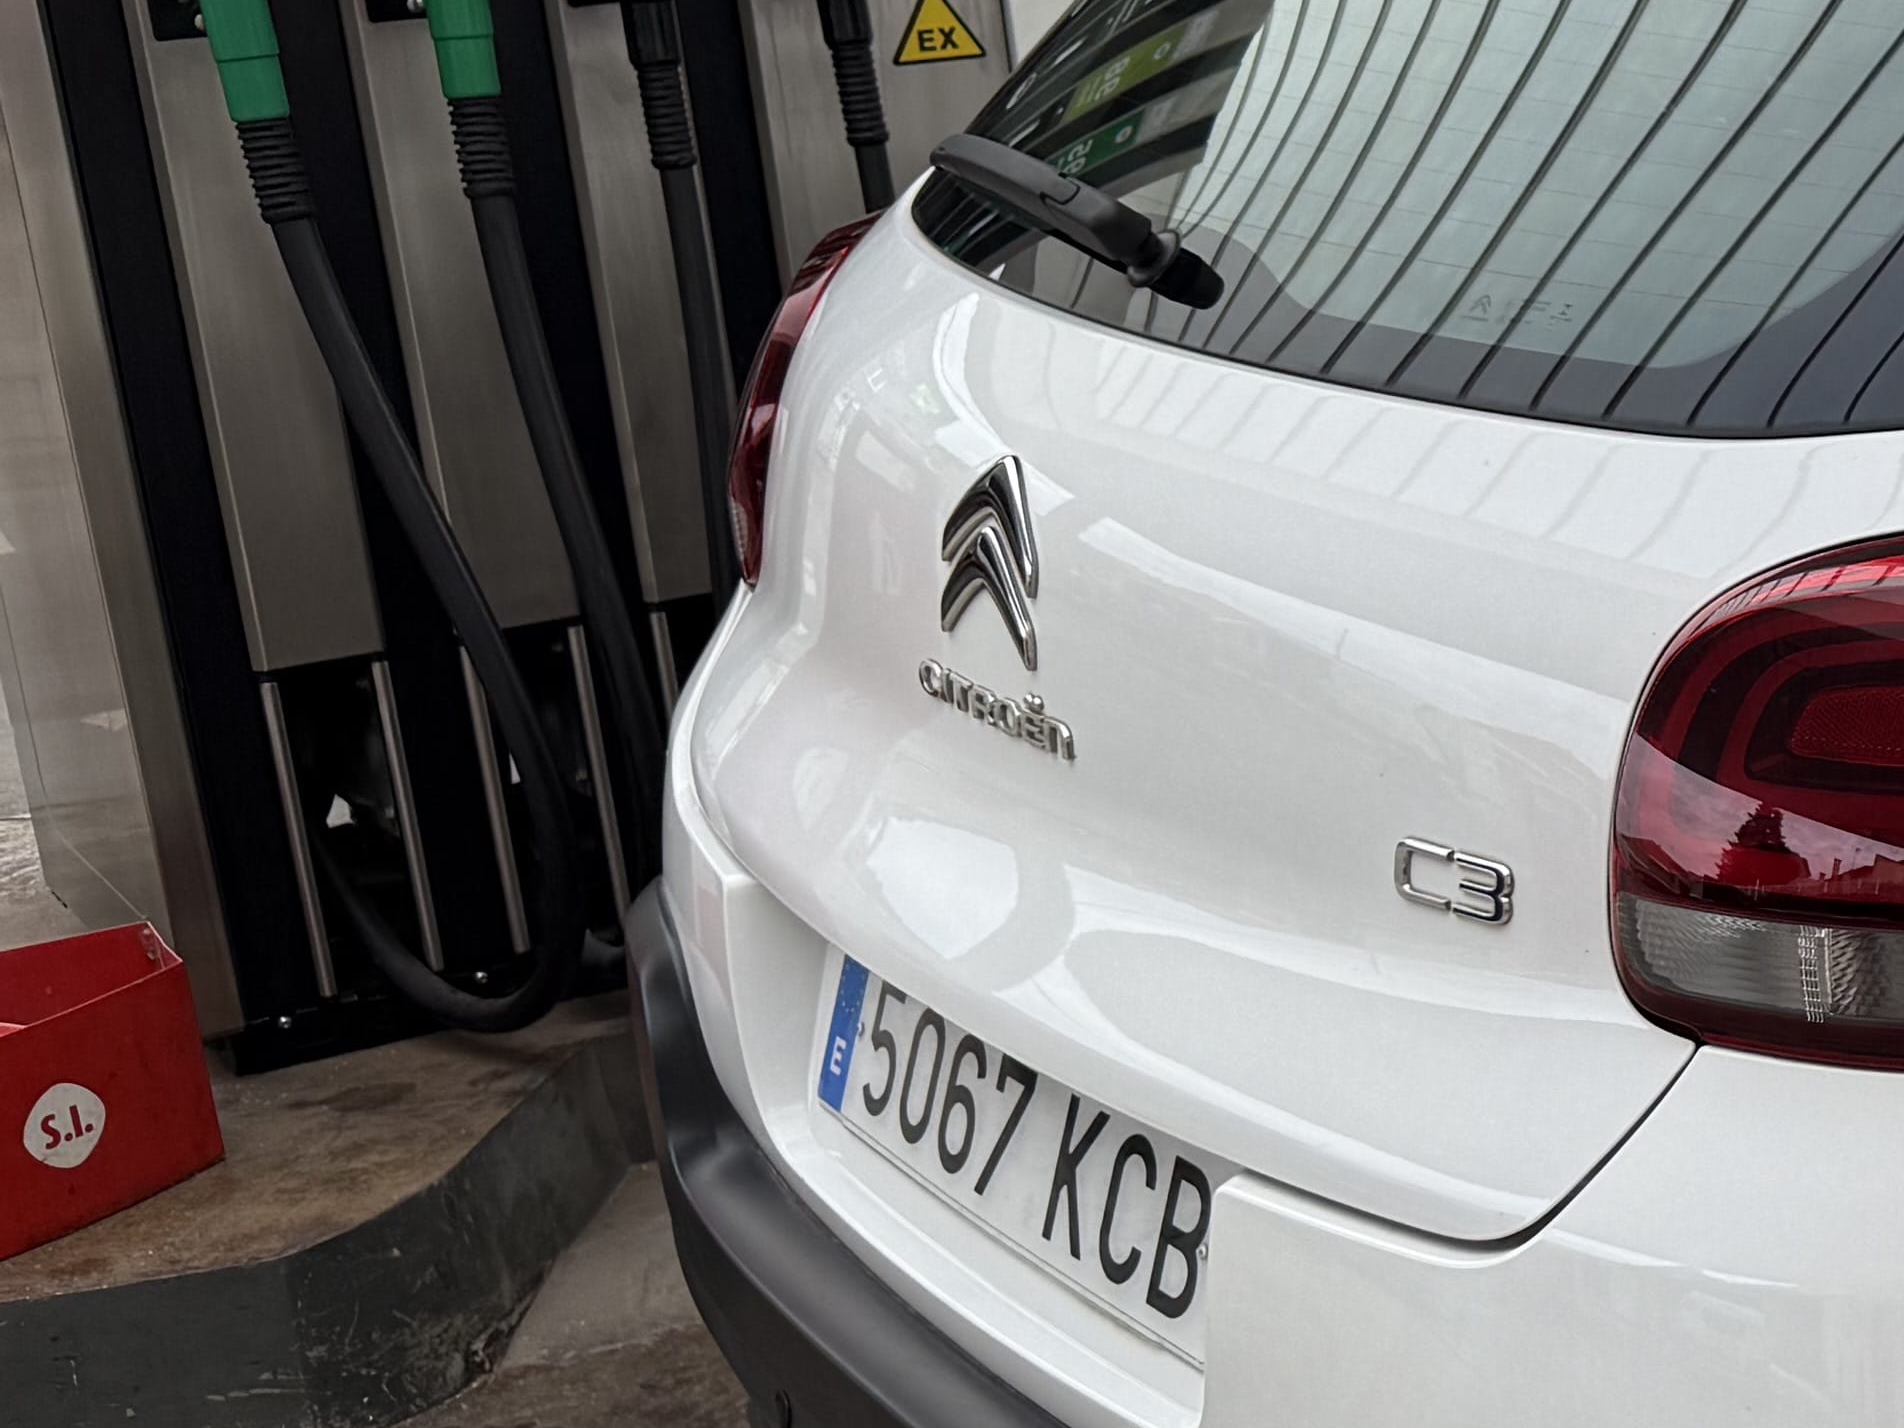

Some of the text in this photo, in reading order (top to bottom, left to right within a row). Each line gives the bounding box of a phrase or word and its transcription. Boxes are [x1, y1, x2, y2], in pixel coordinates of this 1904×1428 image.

[917, 26, 960, 51] EX
[1394, 837, 1515, 925] C3
[830, 1036, 846, 1076] E
[863, 980, 1211, 1319] 5067 KCB
